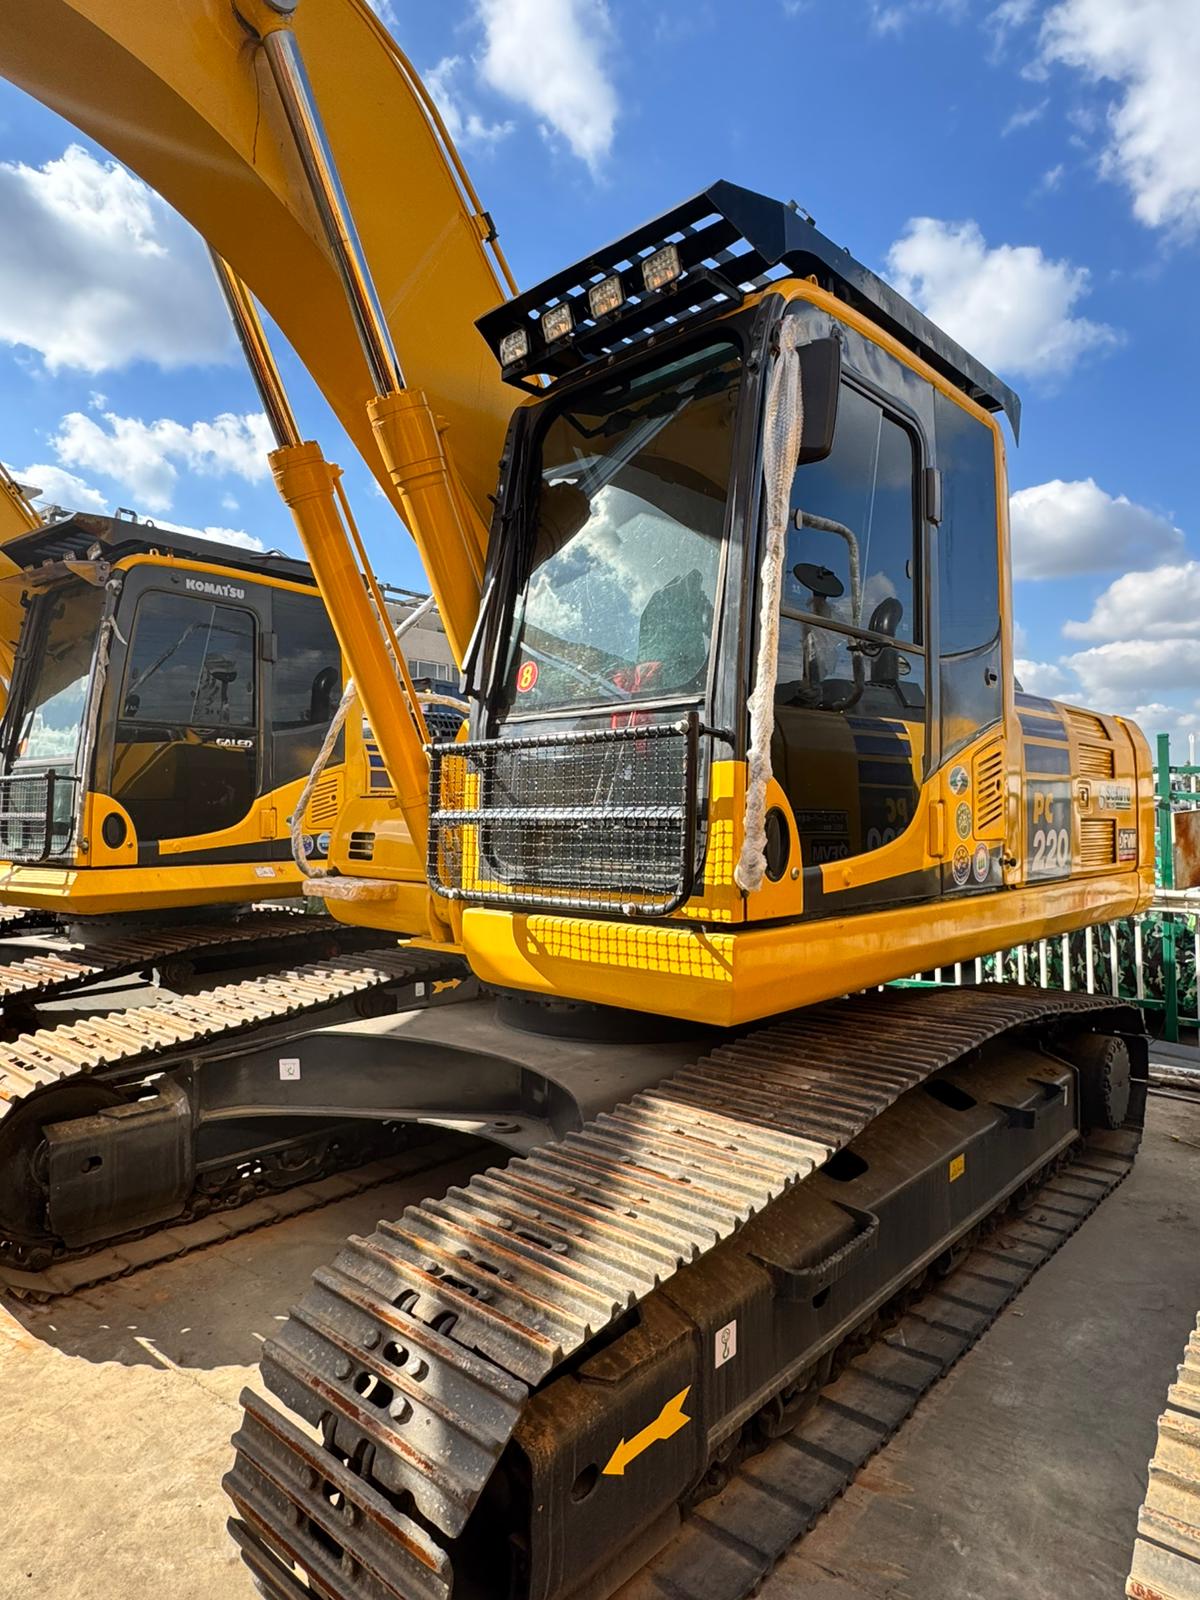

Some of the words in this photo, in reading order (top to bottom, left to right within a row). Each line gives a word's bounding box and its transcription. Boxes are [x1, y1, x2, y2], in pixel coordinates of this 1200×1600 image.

[185, 578, 245, 599] KOMATSU
[521, 665, 533, 688] 8
[1033, 792, 1054, 824] PC
[1032, 829, 1069, 871] 220
